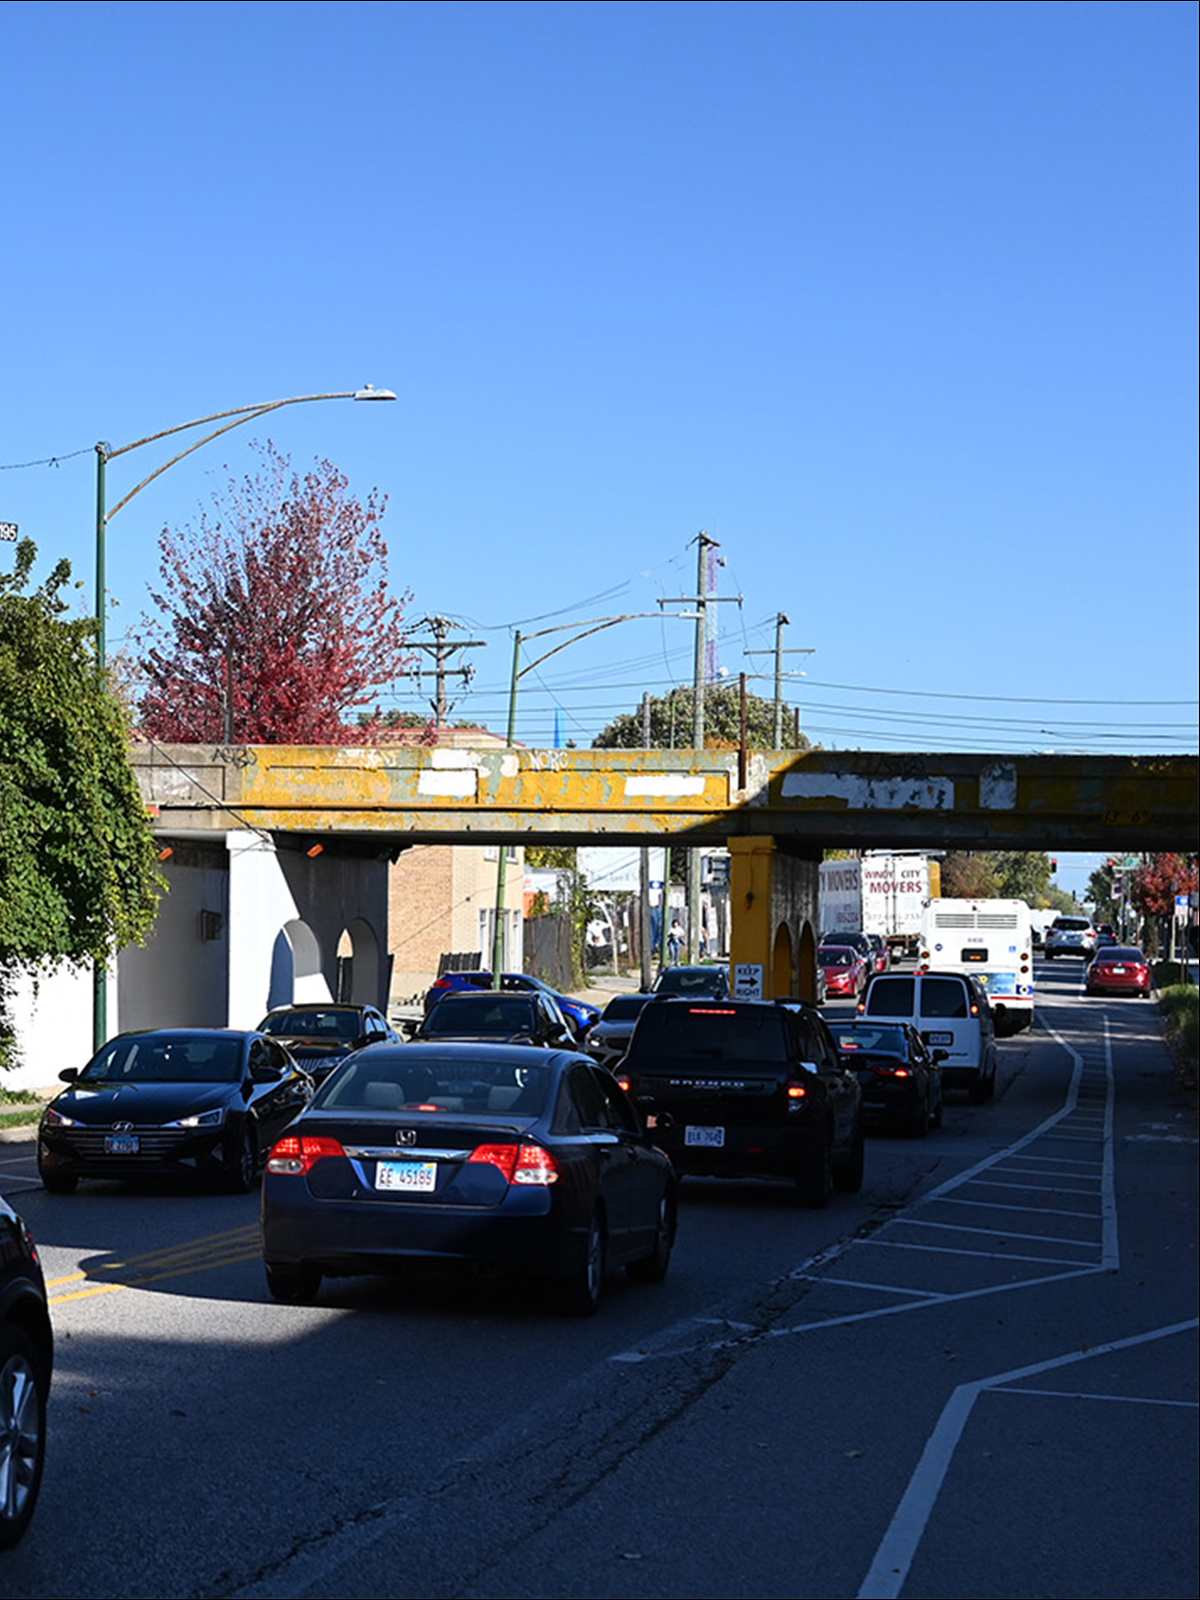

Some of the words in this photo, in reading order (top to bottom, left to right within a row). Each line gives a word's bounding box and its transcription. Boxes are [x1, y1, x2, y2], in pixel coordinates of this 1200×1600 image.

[864, 870, 894, 880] WINDY
[901, 870, 921, 879] CITY
[828, 869, 859, 892] MOVERS
[870, 881, 923, 894] MOVERS
[737, 967, 761, 976] KEEP
[736, 988, 761, 997] RIGHT
[669, 1079, 745, 1087] BRONCO
[380, 1168, 393, 1184] EE
